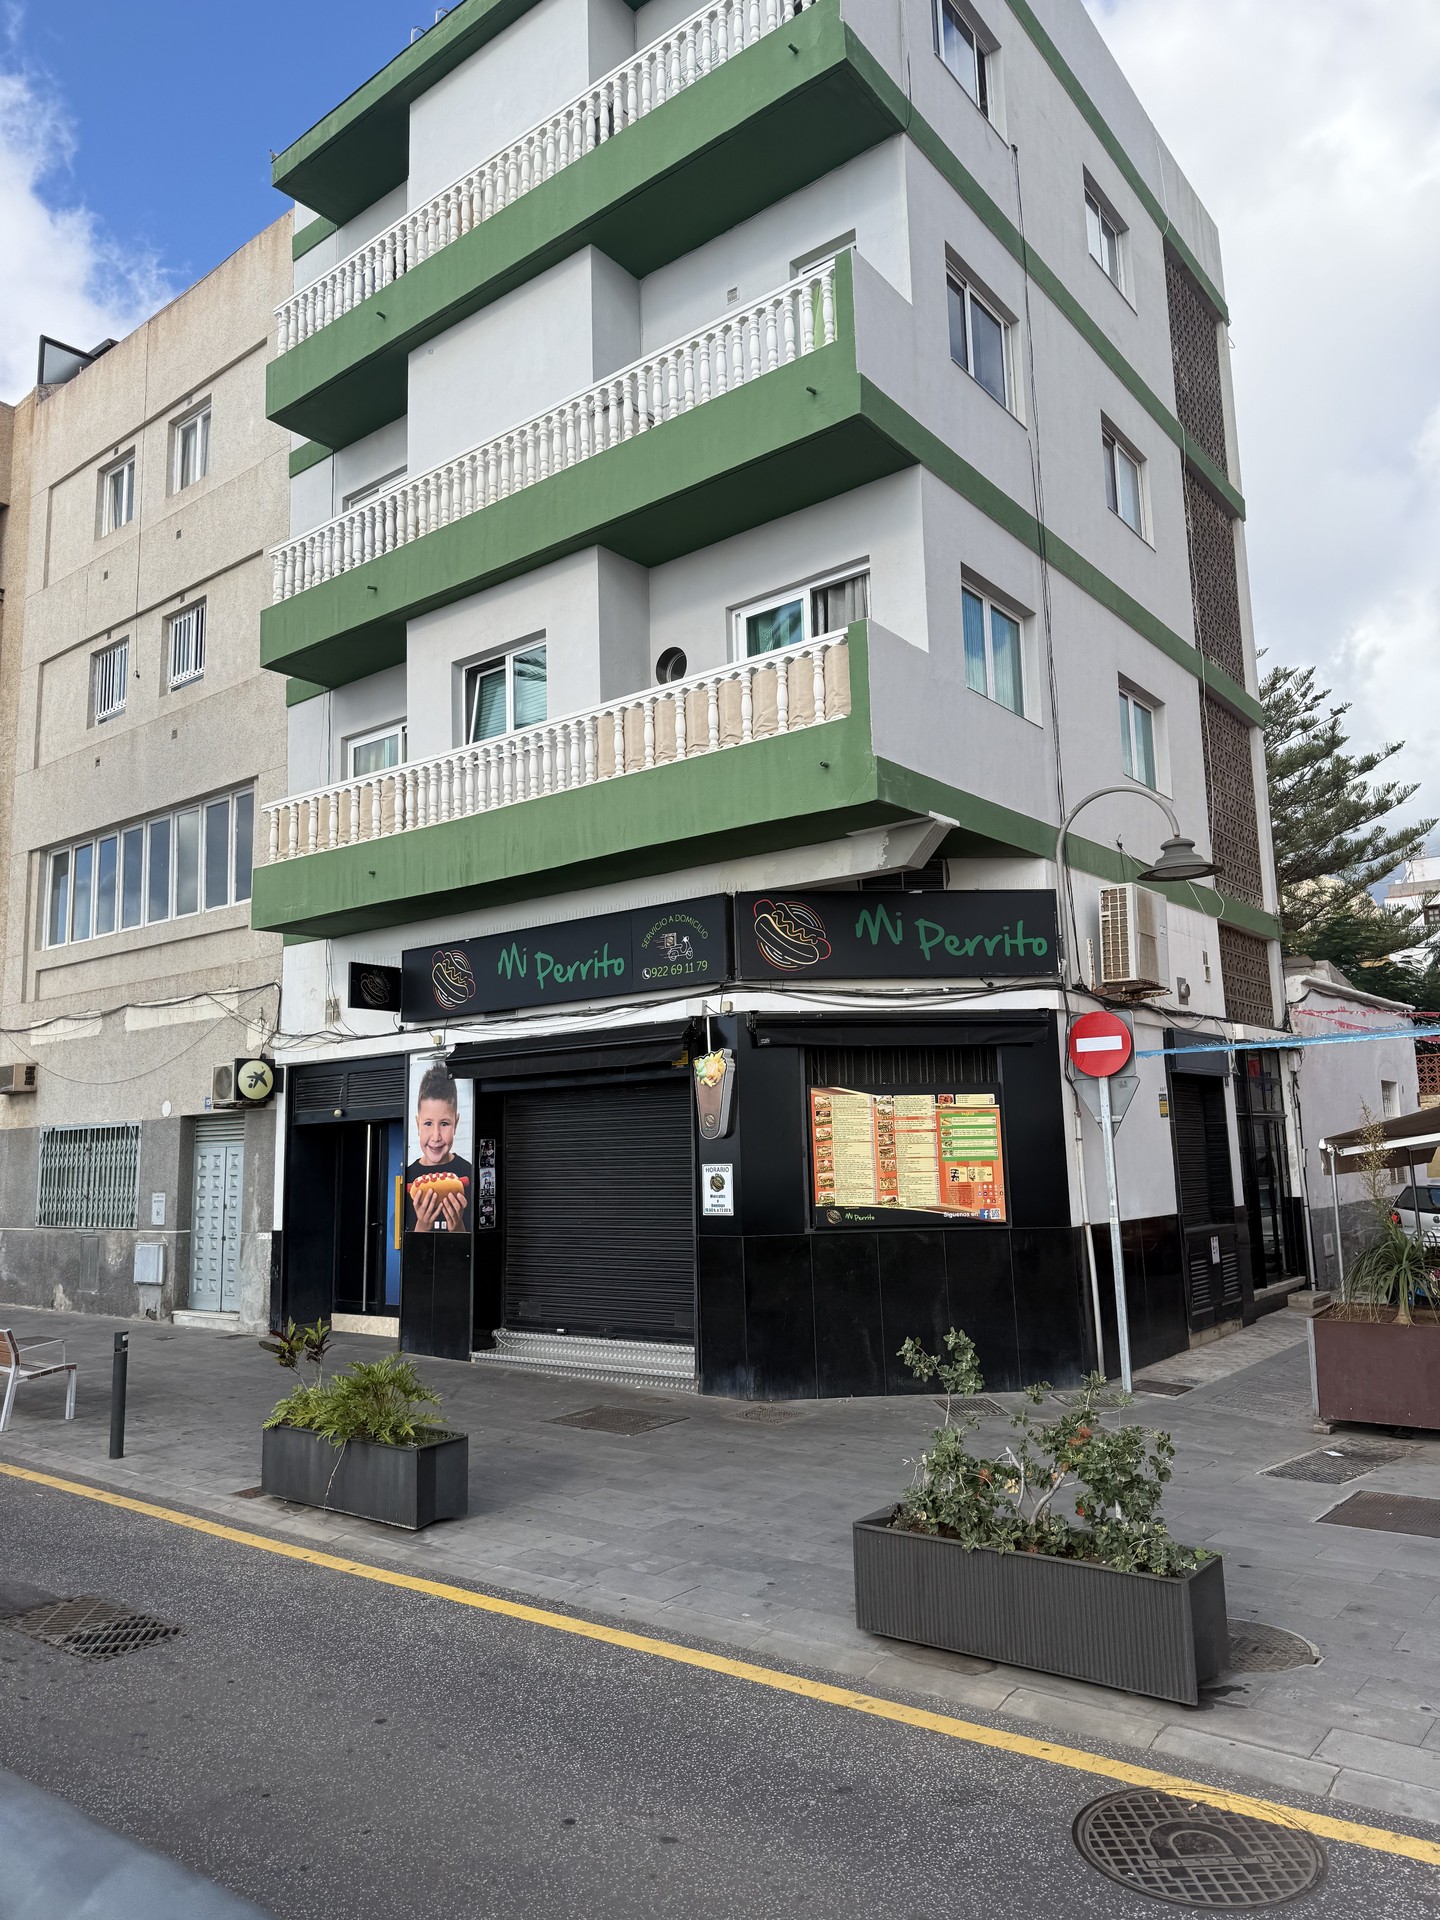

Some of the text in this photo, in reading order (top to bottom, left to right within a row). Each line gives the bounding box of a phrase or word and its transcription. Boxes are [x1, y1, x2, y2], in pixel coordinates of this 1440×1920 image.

[641, 914, 709, 949] SERVICIO A DOMICILIO
[855, 903, 1048, 961] Mi Perrito
[497, 942, 625, 990] Mi Perrito
[651, 960, 708, 978] 922 69 11 79
[854, 1213, 875, 1222] Perrito
